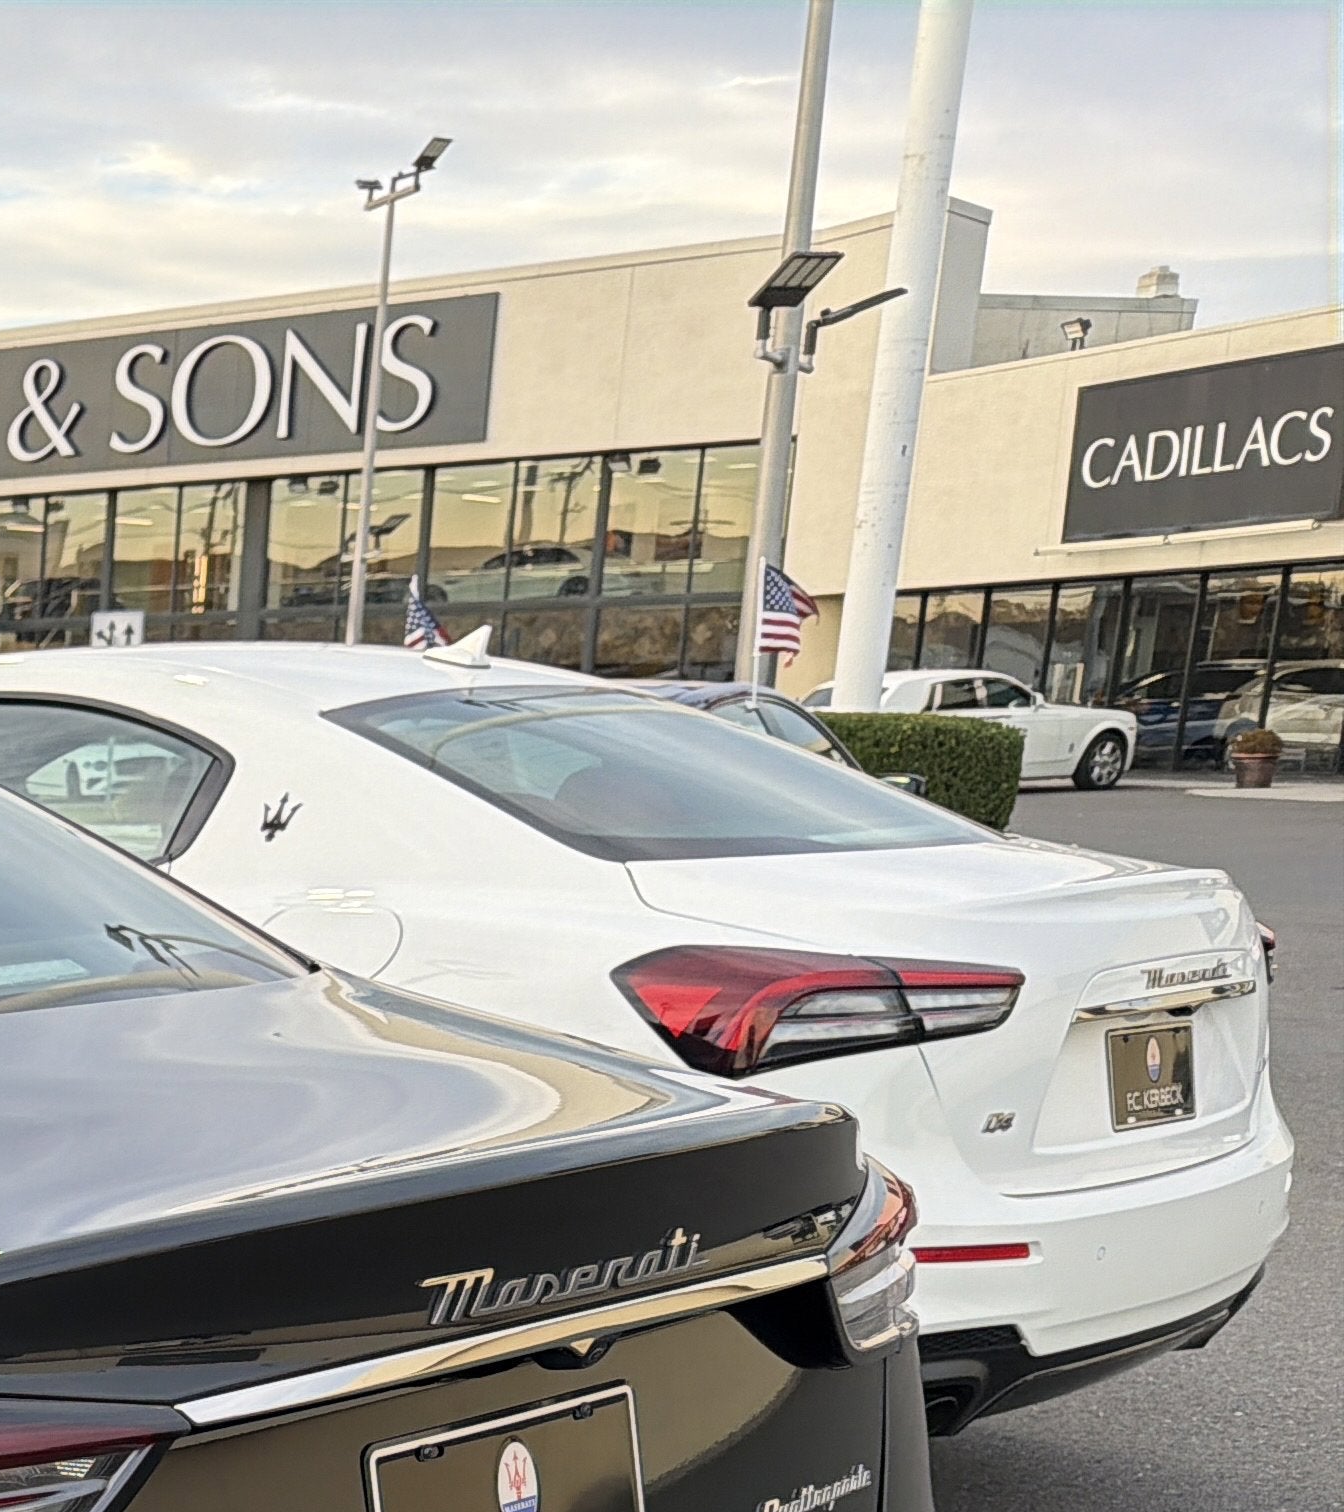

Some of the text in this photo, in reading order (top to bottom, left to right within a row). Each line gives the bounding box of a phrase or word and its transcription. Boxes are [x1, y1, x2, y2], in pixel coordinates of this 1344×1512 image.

[7, 359, 81, 462] &
[109, 314, 435, 453] SONS
[1082, 406, 1334, 489] CADILLACS
[417, 1227, 710, 1325] Maserati
